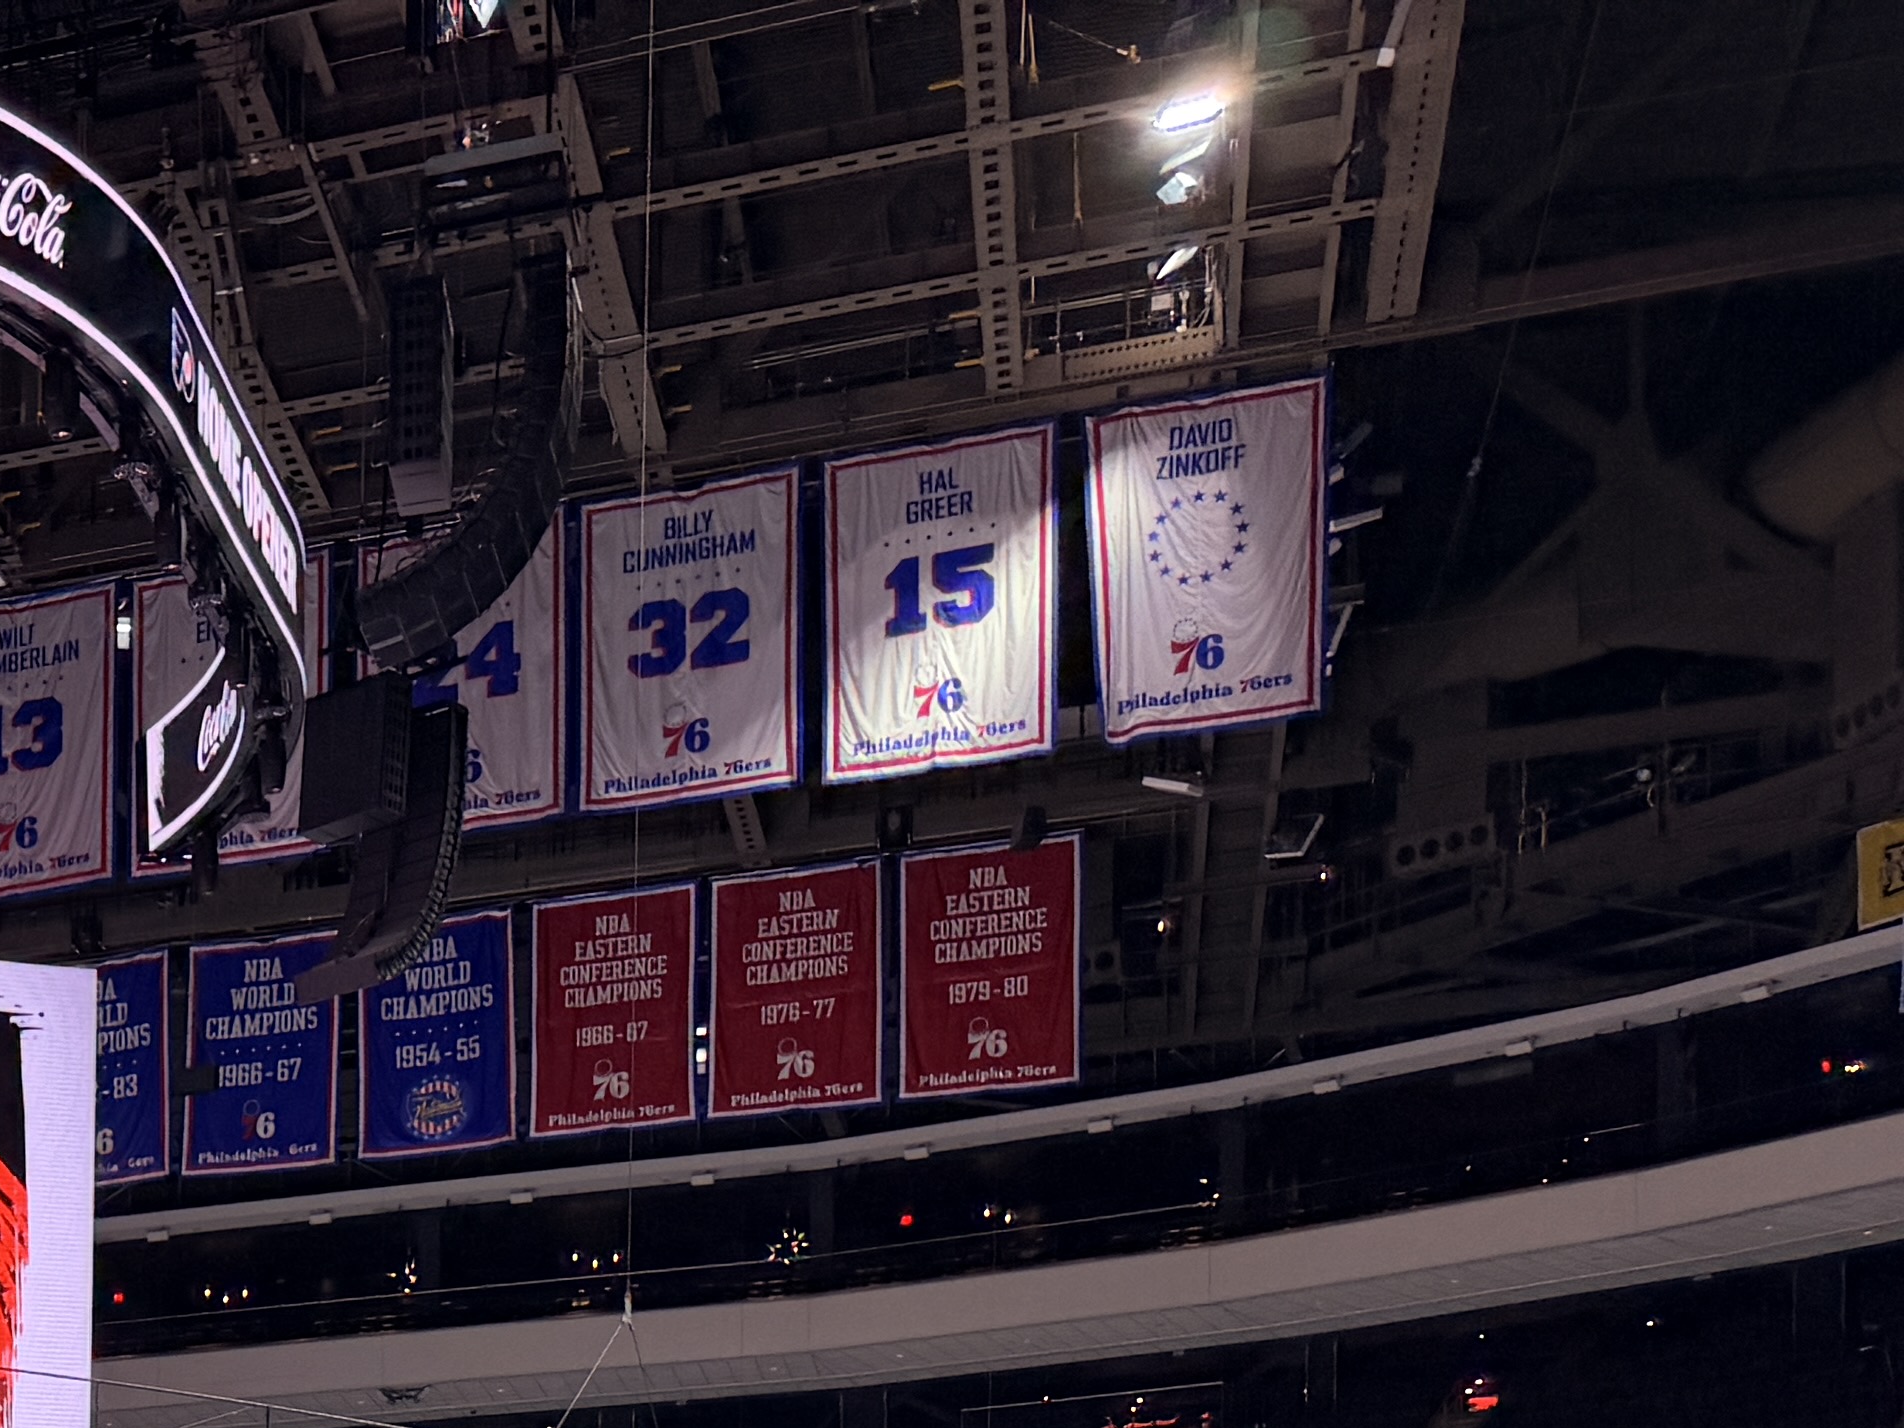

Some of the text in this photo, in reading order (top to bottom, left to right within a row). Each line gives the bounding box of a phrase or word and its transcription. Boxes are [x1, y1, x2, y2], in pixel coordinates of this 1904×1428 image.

[1169, 418, 1233, 452] DAVID
[1156, 445, 1246, 480] ZINKOFF
[919, 471, 960, 495] HAL
[906, 491, 973, 525] GREER
[664, 509, 714, 541] BILLY
[623, 530, 756, 574] CUNNINGHAM
[884, 542, 995, 639] 15
[627, 587, 751, 679] 32
[1170, 633, 1225, 676] 76
[914, 678, 964, 719] 76
[1117, 673, 1292, 716] Philadelphia 76ers
[662, 717, 710, 759] 76
[853, 718, 1027, 757] Philadelphia 76ers
[603, 757, 773, 796] Philadelphia 76ers
[495, 788, 542, 806] 76ers
[48, 851, 91, 870] 76ers
[969, 865, 1007, 889] NBA
[778, 890, 816, 913] NBA
[946, 885, 1030, 915] EASTERN
[595, 913, 631, 936] NBA
[757, 908, 839, 938] EASTERN
[929, 907, 1048, 942] CONFERENCE
[417, 935, 458, 962] NBA
[574, 933, 652, 962] EASTERN
[741, 931, 854, 964] CONFERENCE
[934, 932, 1043, 965] CHAMPIONS
[244, 956, 283, 982] NBA
[405, 960, 472, 993] WORLD
[559, 955, 668, 987] CONFERENCE
[745, 955, 849, 987] CHAMPIONS
[230, 982, 296, 1011] WORLD
[381, 983, 494, 1022] CHAMPIONS
[564, 978, 663, 1009] CHAMPIONS
[948, 974, 1029, 1005] 1979-80
[205, 1006, 319, 1042] CHAMPIONS
[760, 997, 836, 1026] 1976-77
[395, 1036, 481, 1070] 1954-55
[967, 1029, 1008, 1061] 76
[219, 1057, 302, 1088] 1966-67
[775, 1049, 815, 1081] 76
[918, 1066, 1014, 1087] Philadelphia
[592, 1071, 630, 1101] 76
[730, 1086, 822, 1108] Philadelphia
[548, 1107, 635, 1128] Philadelphia
[198, 1146, 280, 1165] Philadelphia
